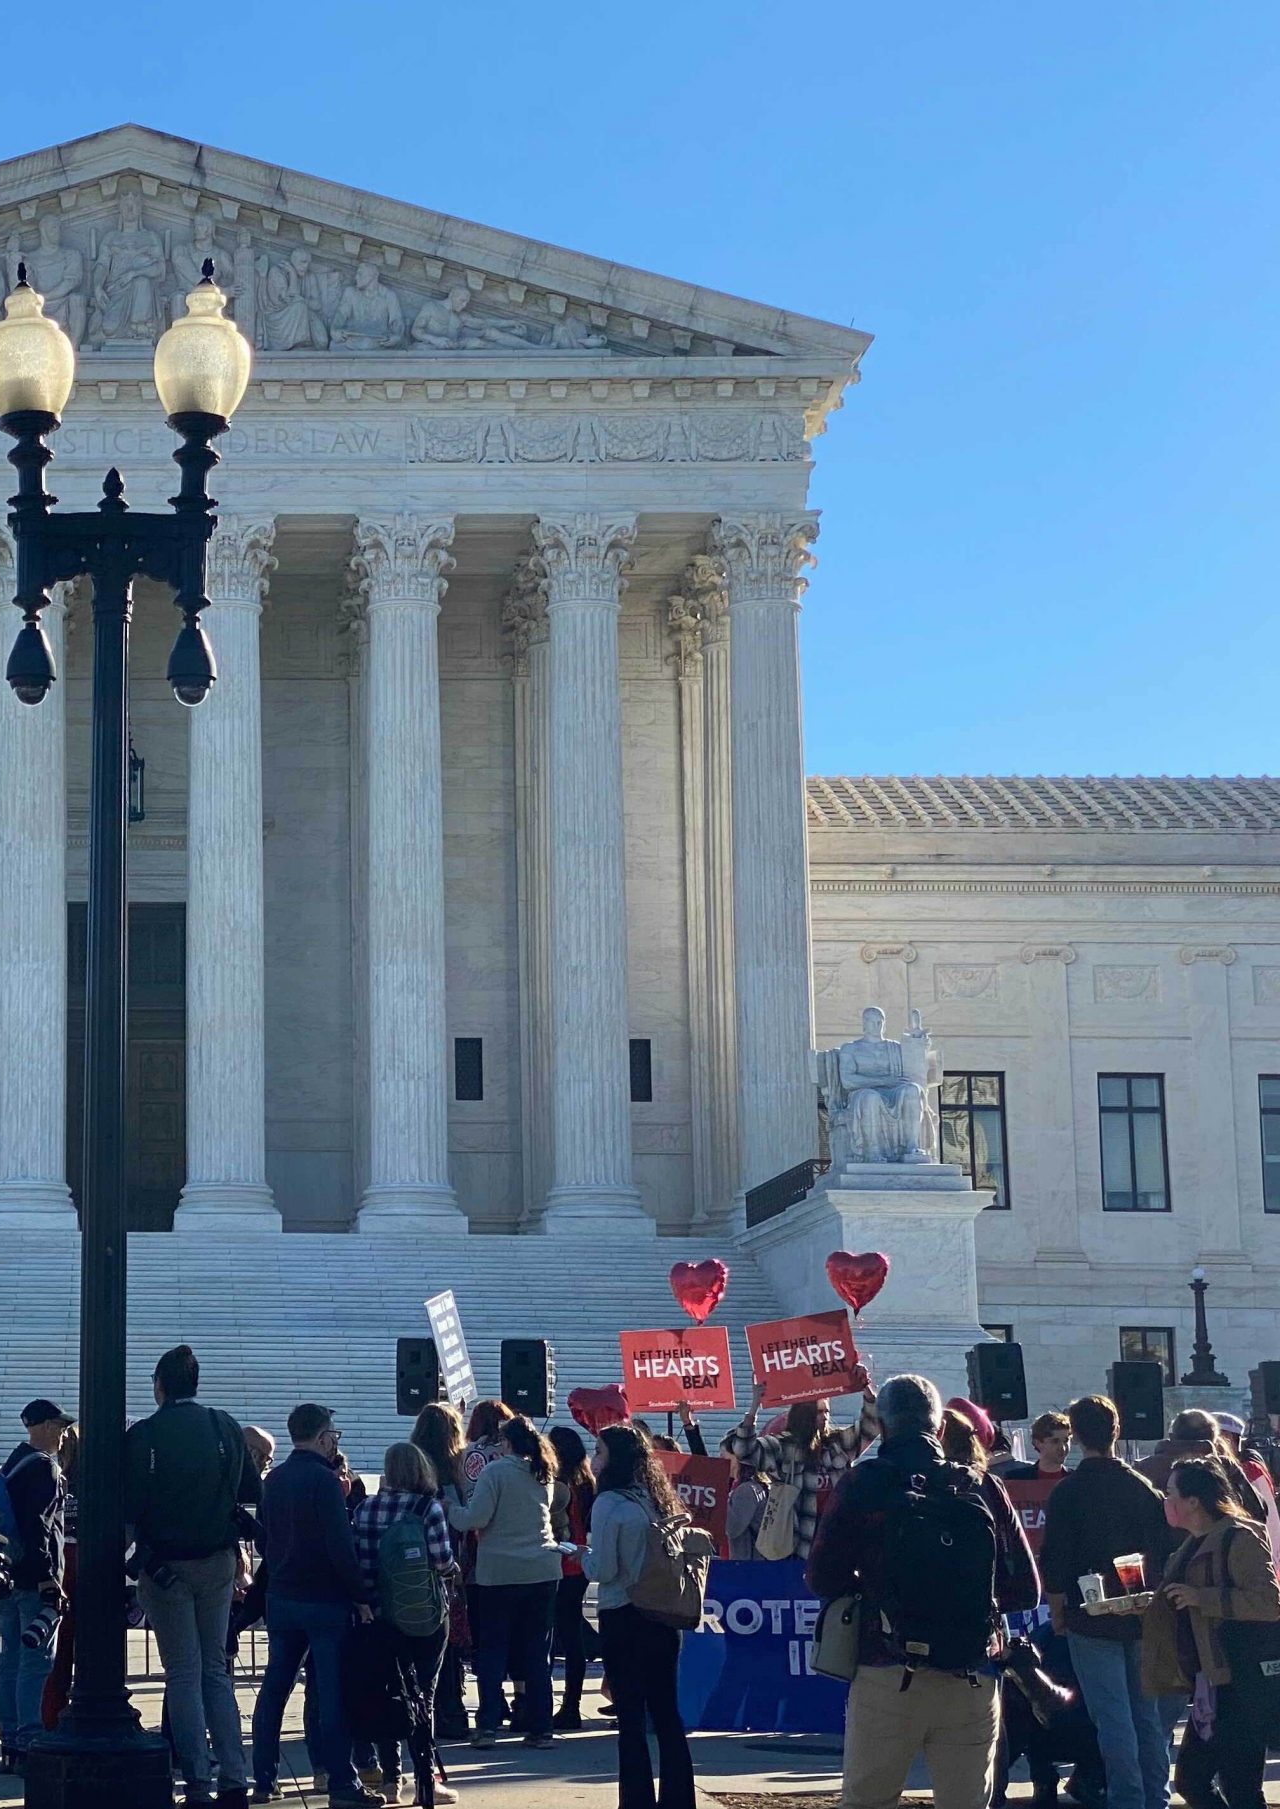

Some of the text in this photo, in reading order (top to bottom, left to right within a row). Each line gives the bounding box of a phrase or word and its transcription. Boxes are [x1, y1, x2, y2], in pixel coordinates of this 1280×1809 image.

[52, 427, 154, 454] STICE
[310, 427, 382, 454] LAW
[632, 1348, 693, 1361] LET THEIR
[633, 1355, 720, 1379] HEARTS
[761, 1340, 846, 1373] HEARTS
[682, 1374, 719, 1390] BEAT
[676, 1483, 716, 1508] RTS
[694, 1598, 821, 1635] ROTE
